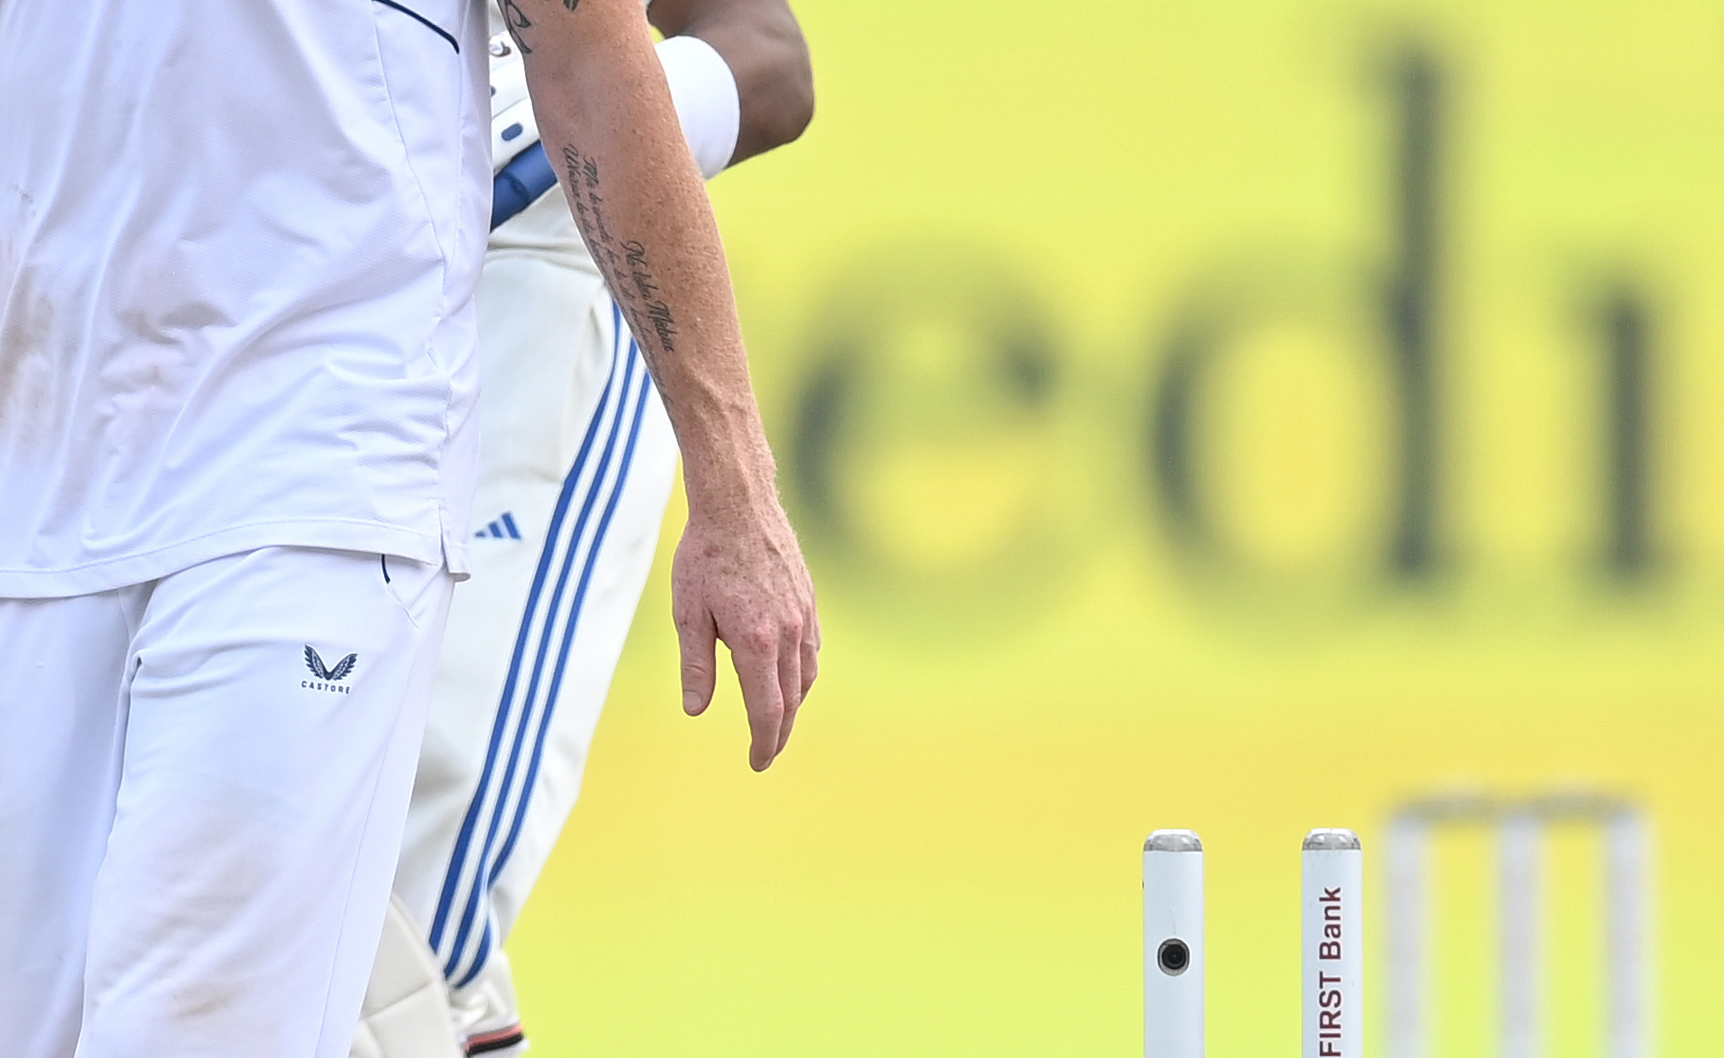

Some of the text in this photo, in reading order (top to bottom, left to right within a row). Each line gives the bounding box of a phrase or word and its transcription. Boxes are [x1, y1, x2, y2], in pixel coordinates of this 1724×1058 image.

[301, 680, 351, 694] CASTORE
[1319, 887, 1342, 1057] FIRST Bank
